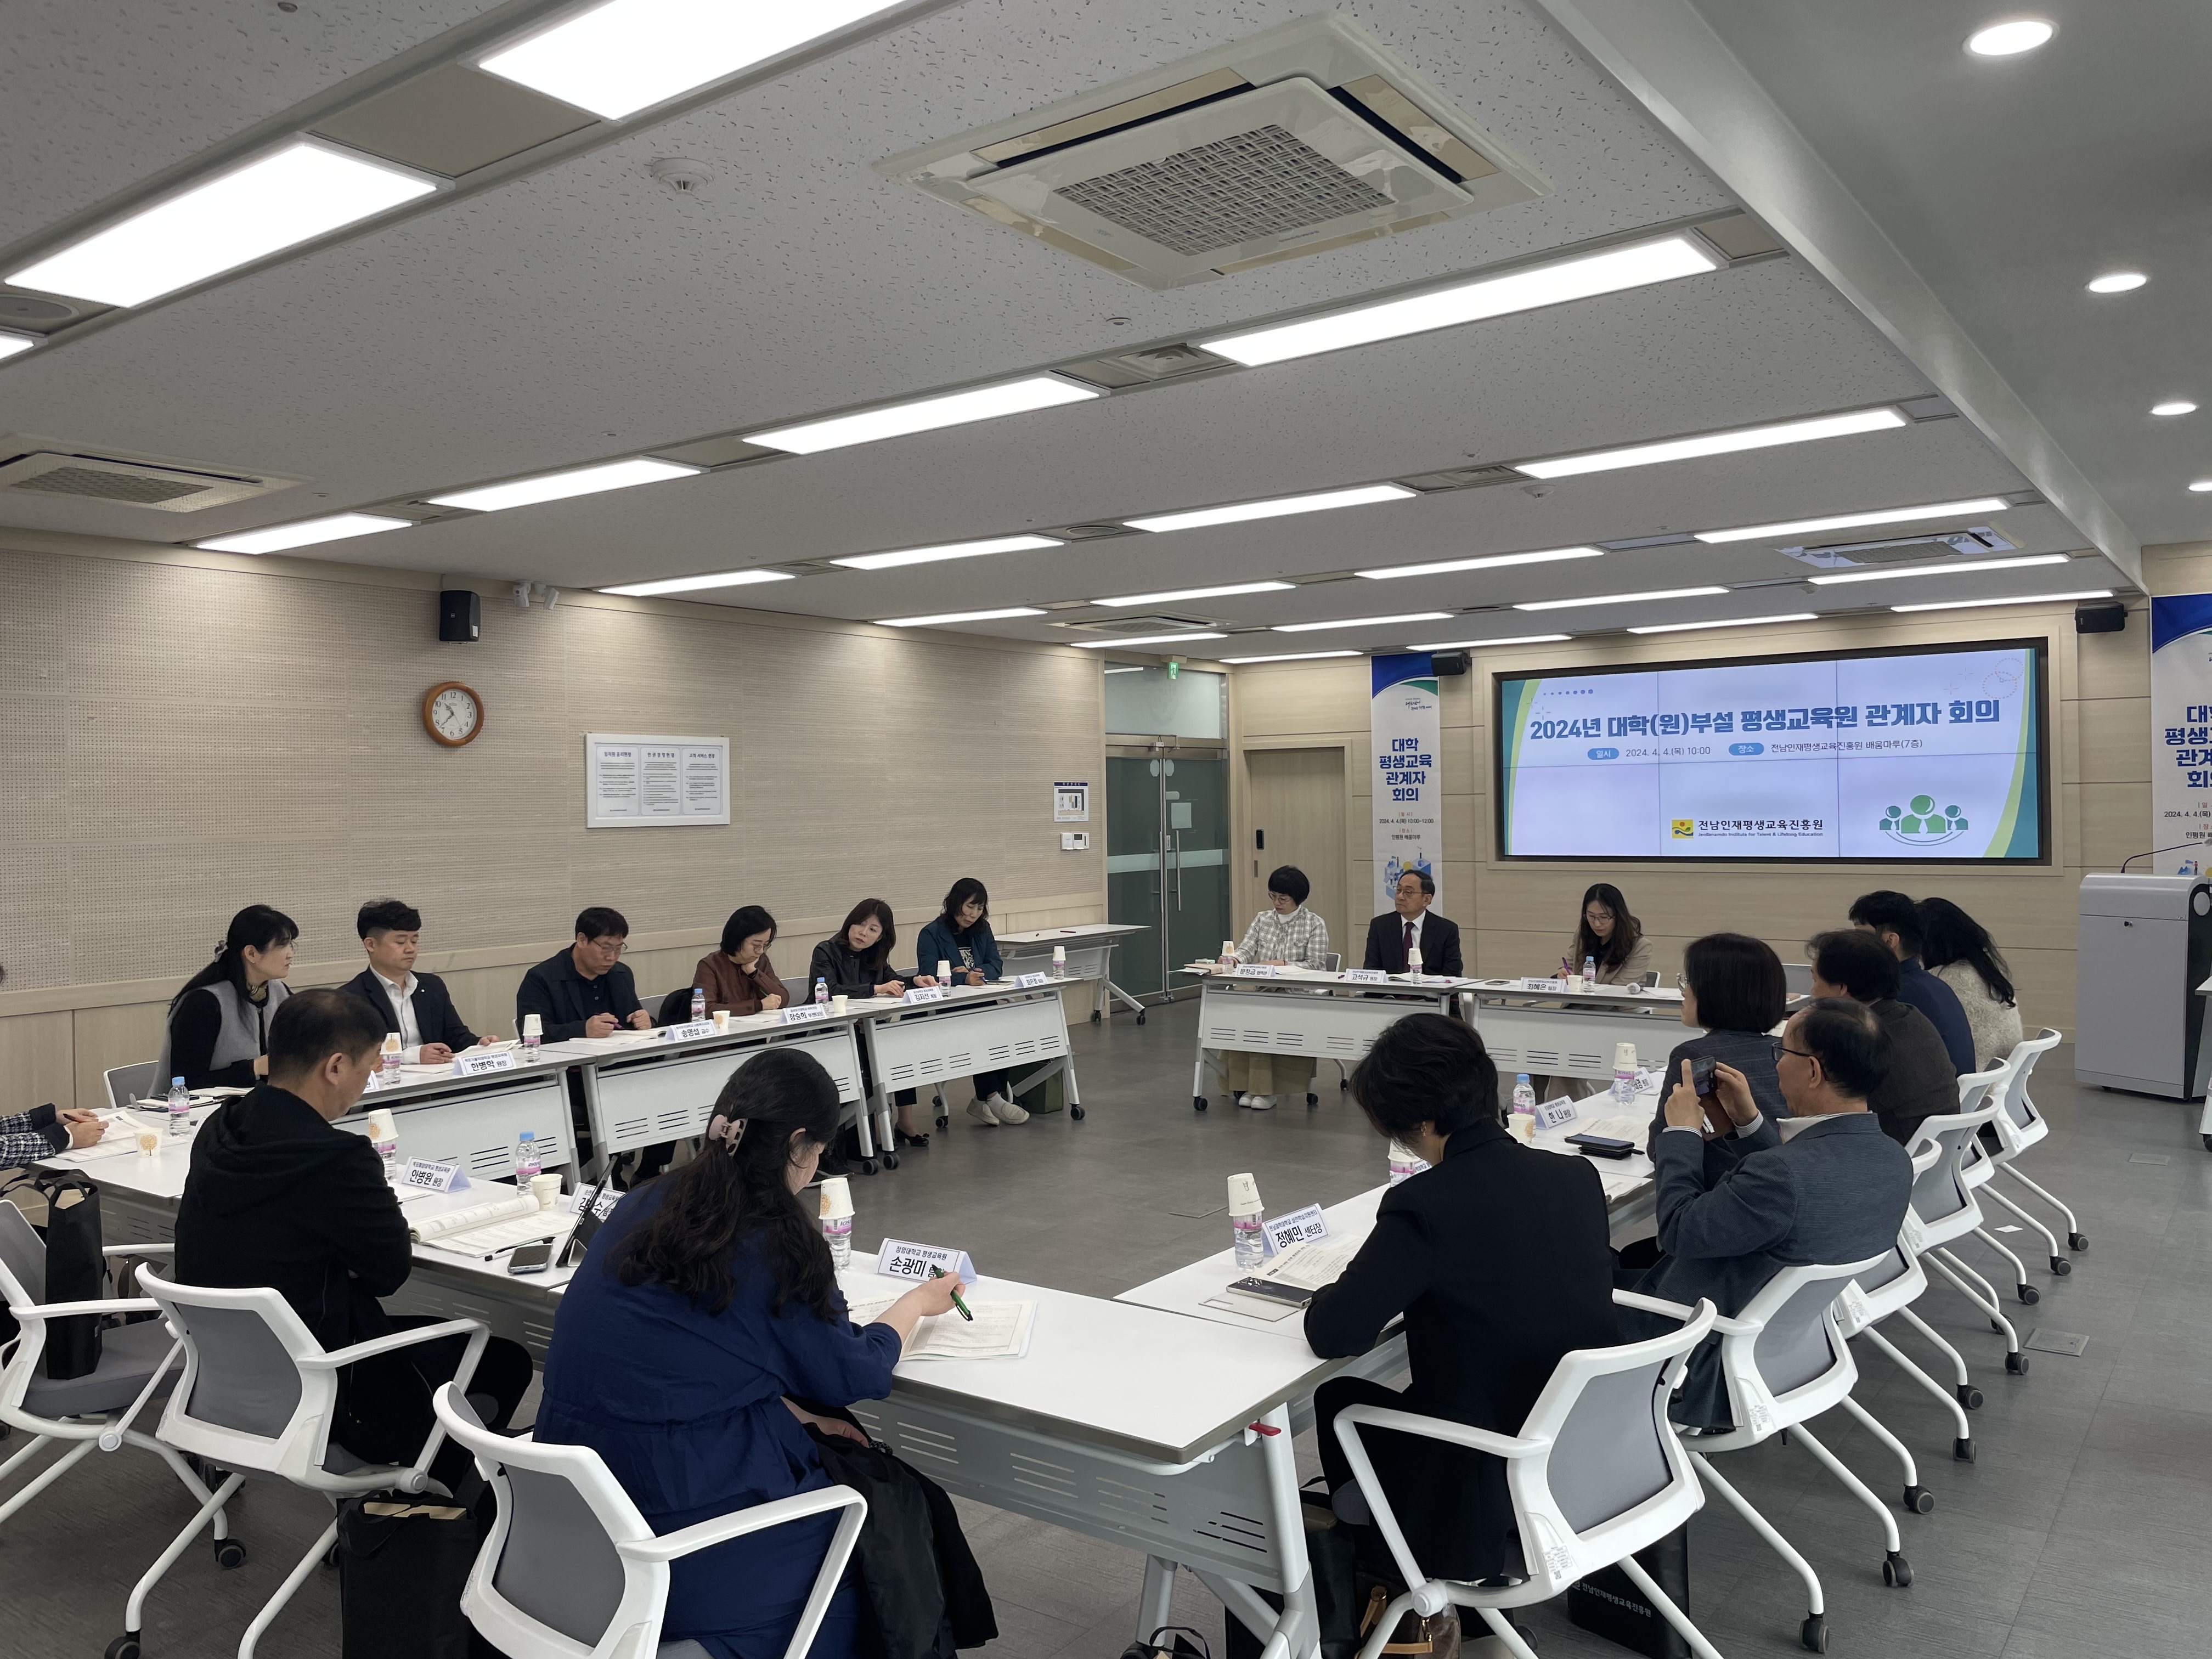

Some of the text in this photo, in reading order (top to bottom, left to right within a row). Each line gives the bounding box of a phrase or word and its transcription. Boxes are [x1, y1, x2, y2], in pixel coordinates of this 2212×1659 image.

[1530, 699, 2000, 740] 2024년 대학(원)부설 평생교육원 관계자 회의
[2187, 706, 2212, 723] 대
[2165, 727, 2212, 745] 평생
[1392, 738, 1419, 752] 대학
[1626, 749, 1650, 757] 2024.
[1663, 747, 1684, 756] 4.(목)
[1688, 747, 1711, 755] 10:00
[1737, 745, 1754, 753] 장소
[1771, 739, 1922, 753] 전남인재평생교육진흥원 배움마루(7층)
[1379, 754, 1432, 769] 평생교육
[1596, 750, 1611, 758] 일시
[1386, 771, 1426, 785] 관계자
[2187, 770, 2212, 788] 회
[1392, 787, 1419, 802] 회의
[1698, 819, 1823, 831] 전남인재평생교육진흥원
[1304, 1222, 1323, 1237] 센터장
[889, 1256, 927, 1277] 손광미
[1582, 1582, 1651, 1617] 전남인재평생교육진흥원
